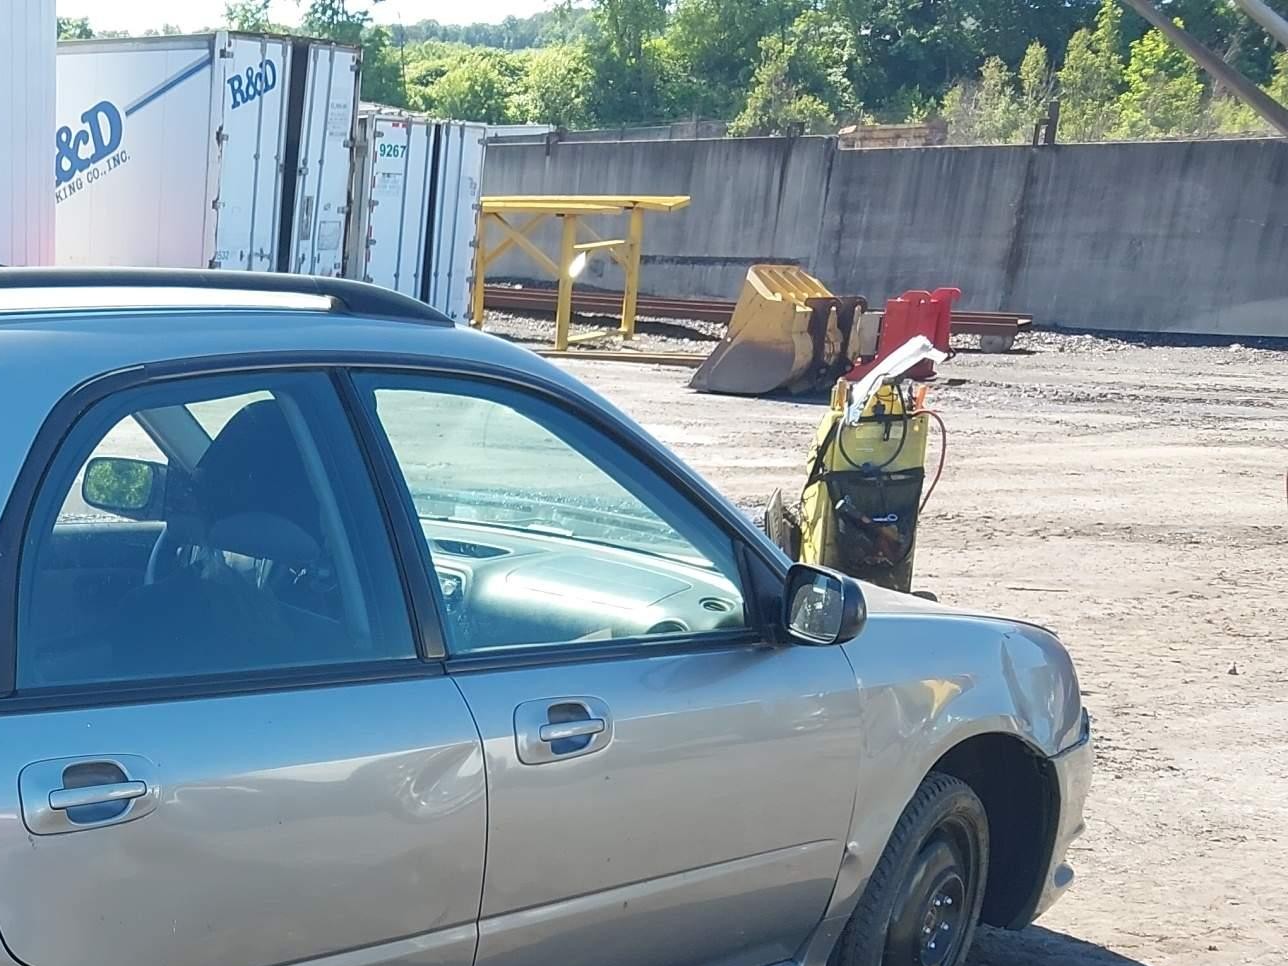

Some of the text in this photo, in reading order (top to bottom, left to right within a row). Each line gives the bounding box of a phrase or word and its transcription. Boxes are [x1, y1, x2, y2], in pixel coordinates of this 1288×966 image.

[226, 59, 277, 110] R&D
[55, 100, 123, 188] &D
[379, 143, 407, 158] 9267
